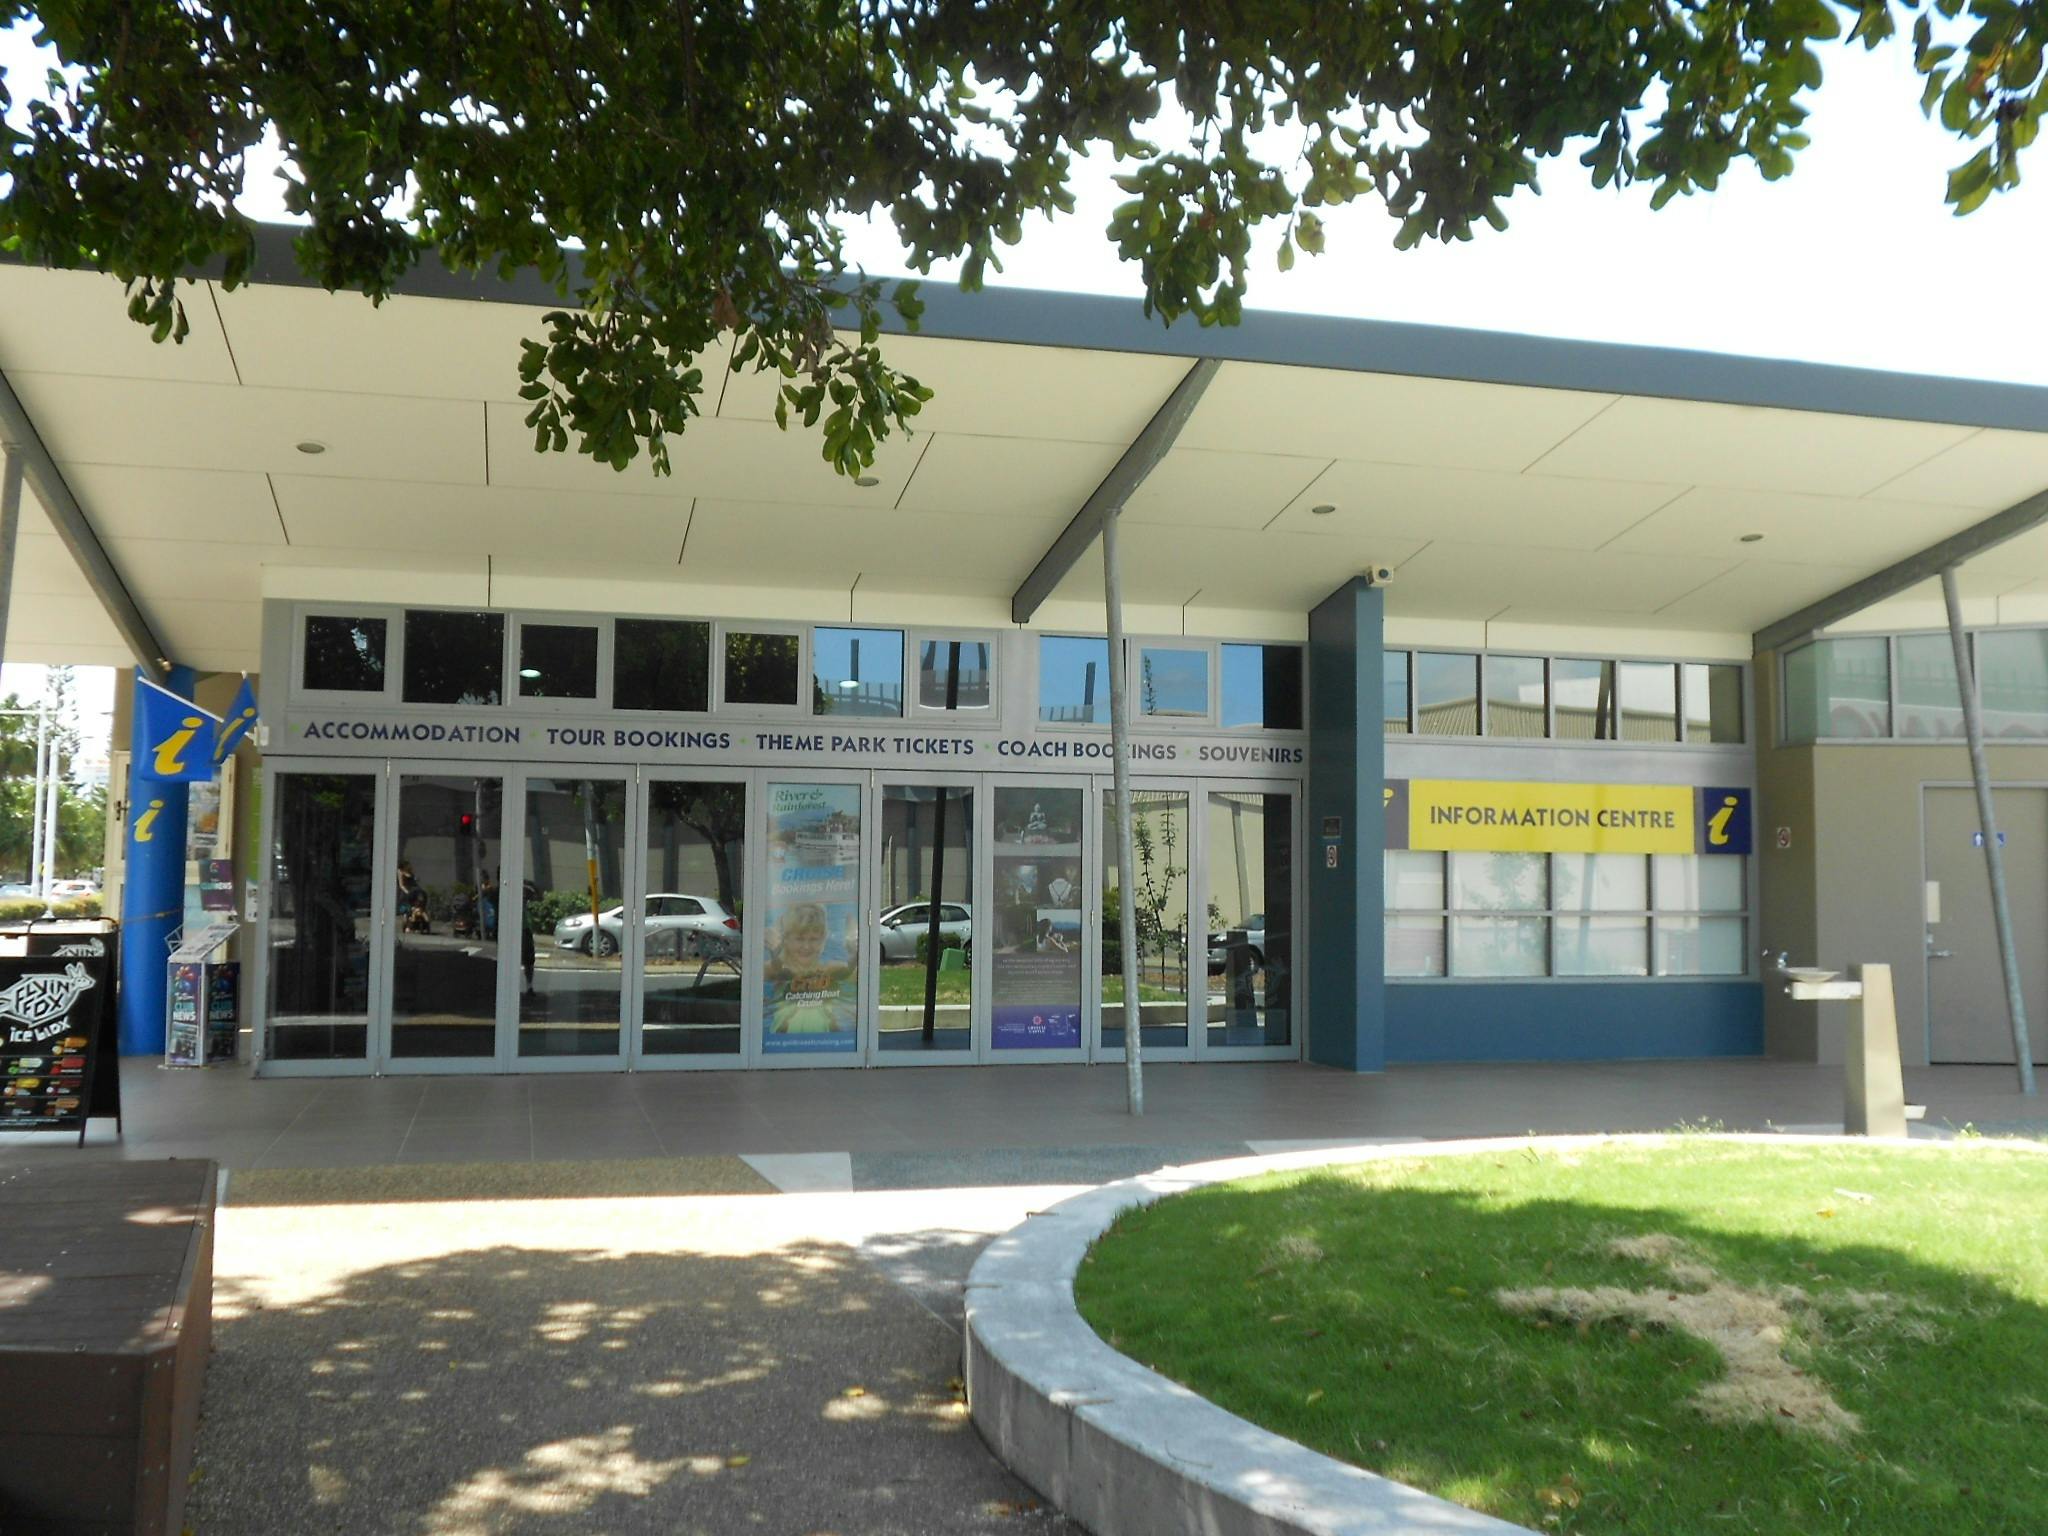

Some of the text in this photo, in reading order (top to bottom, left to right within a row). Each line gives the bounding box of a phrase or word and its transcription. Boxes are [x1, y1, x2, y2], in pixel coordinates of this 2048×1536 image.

[304, 721, 520, 745] ACCOMMODATION
[547, 728, 731, 749] TOUR BOOKINGS
[756, 734, 974, 755] THEME PARK TICKETS
[997, 740, 1177, 760] COACH BOOINGS
[1199, 745, 1304, 763] SOUVENIRS
[775, 789, 807, 802] River
[773, 801, 826, 812] Rainforest
[1430, 805, 1675, 829] INFORMATION CENTRE
[16, 980, 70, 1013] FLYIN
[23, 993, 65, 1018] FOX
[785, 990, 821, 1001] Catching
[10, 1027, 34, 1042] ice
